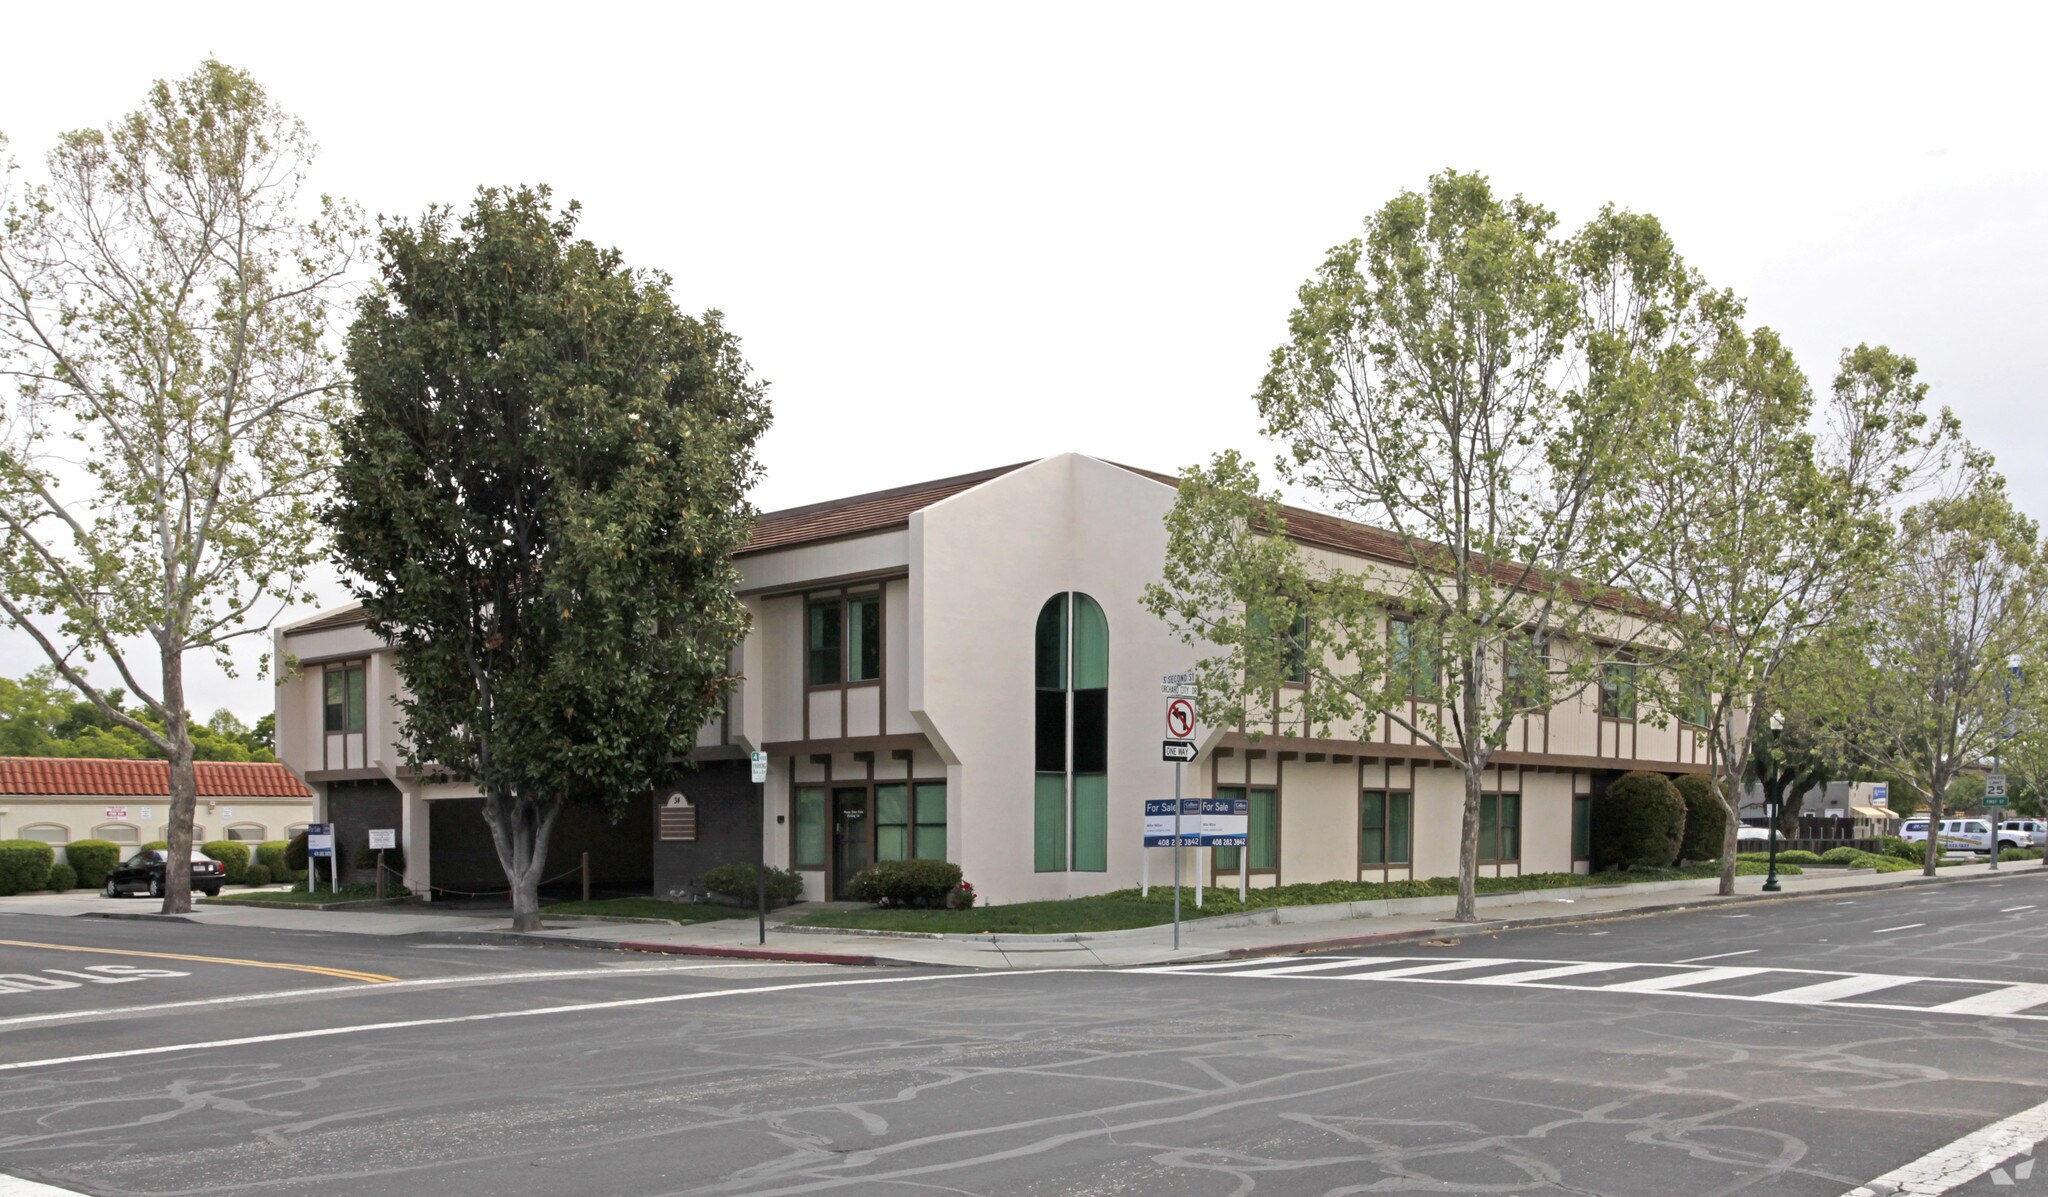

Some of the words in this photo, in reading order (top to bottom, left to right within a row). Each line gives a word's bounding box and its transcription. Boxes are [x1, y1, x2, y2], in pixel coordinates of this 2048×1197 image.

[1163, 676, 1167, 684] S
[1168, 674, 1187, 684] SECOND
[1189, 673, 1195, 682] ST
[1161, 685, 1179, 694] ORCHARD
[1181, 686, 1189, 694] CITY
[1192, 687, 1198, 695] DR
[1167, 747, 1177, 756] ONE
[1178, 747, 1189, 756] WAY
[1987, 786, 2004, 794] 25
[1147, 803, 1160, 813] For
[1202, 802, 1214, 811] For
[1215, 801, 1229, 811] Sale
[1184, 838, 1199, 846] 3842
[1212, 838, 1222, 846] 408
[1223, 838, 1233, 846] 282
[1233, 838, 1246, 846] 3842
